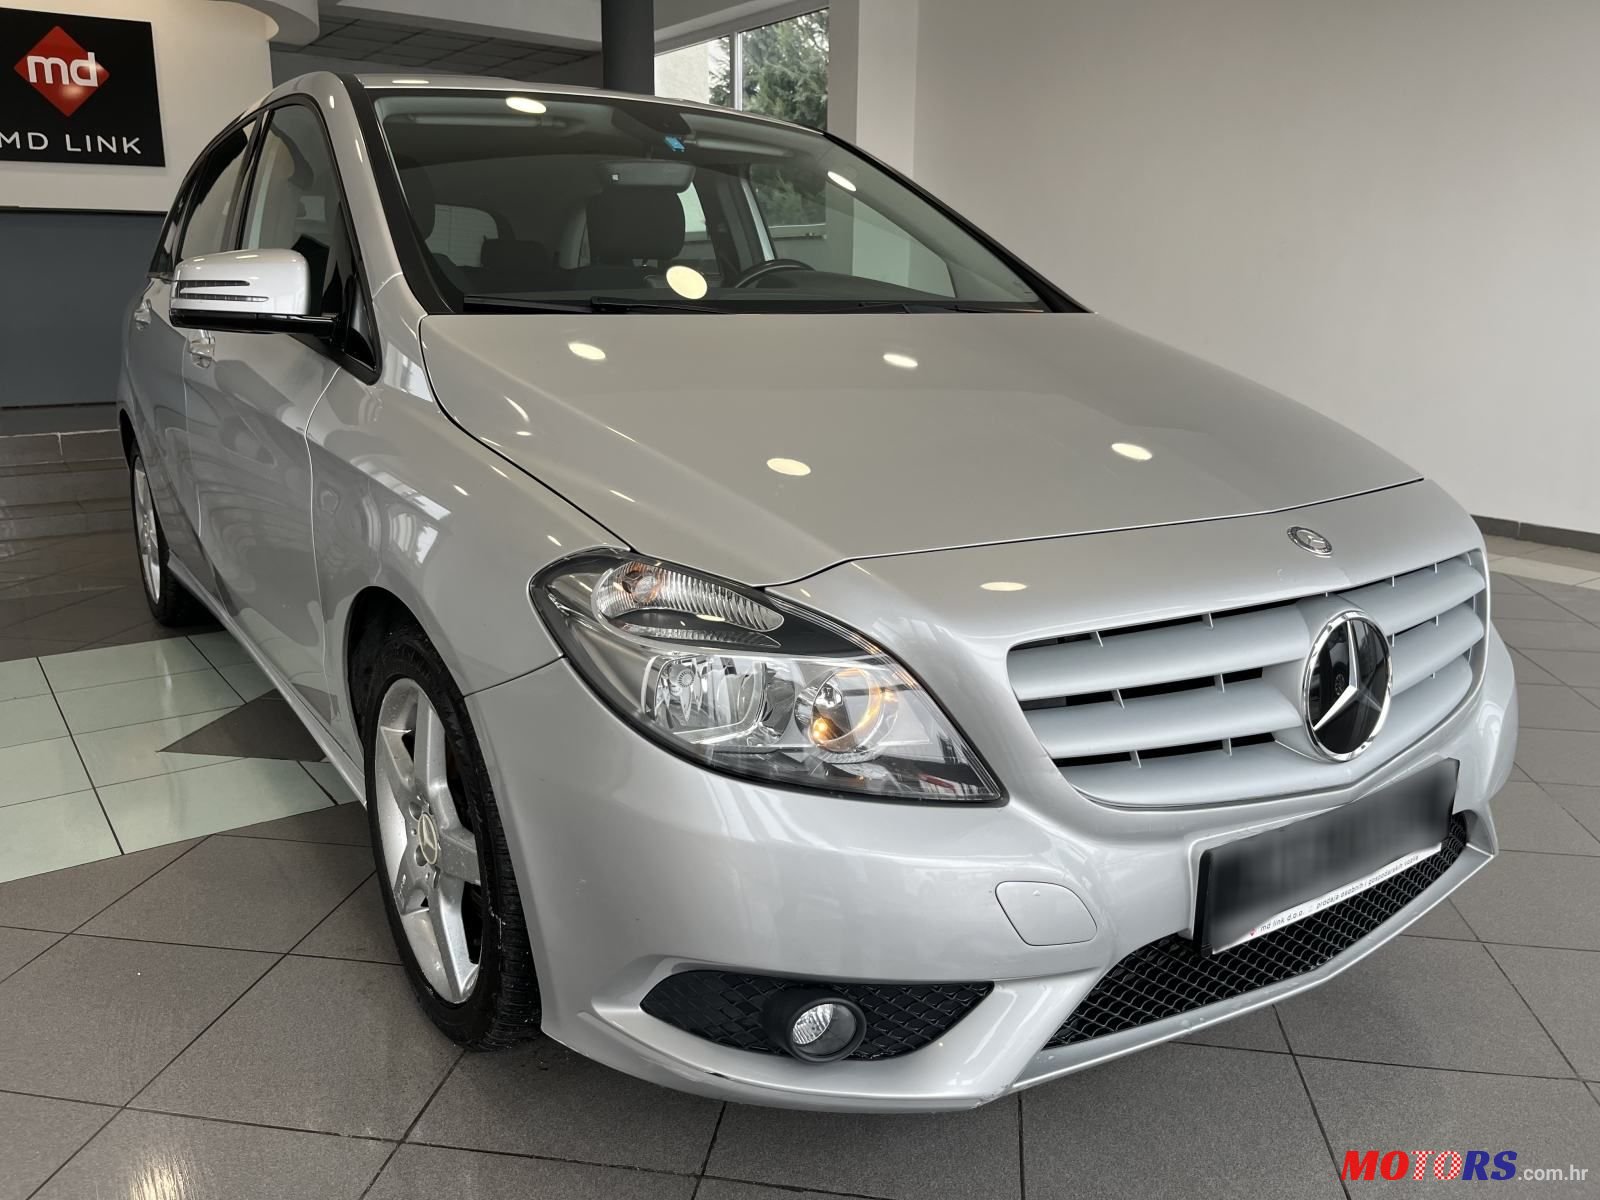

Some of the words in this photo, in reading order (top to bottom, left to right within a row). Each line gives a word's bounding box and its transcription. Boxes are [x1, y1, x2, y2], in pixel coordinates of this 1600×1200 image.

[27, 52, 98, 87] md
[0, 131, 49, 150] MD
[65, 134, 142, 154] LINK
